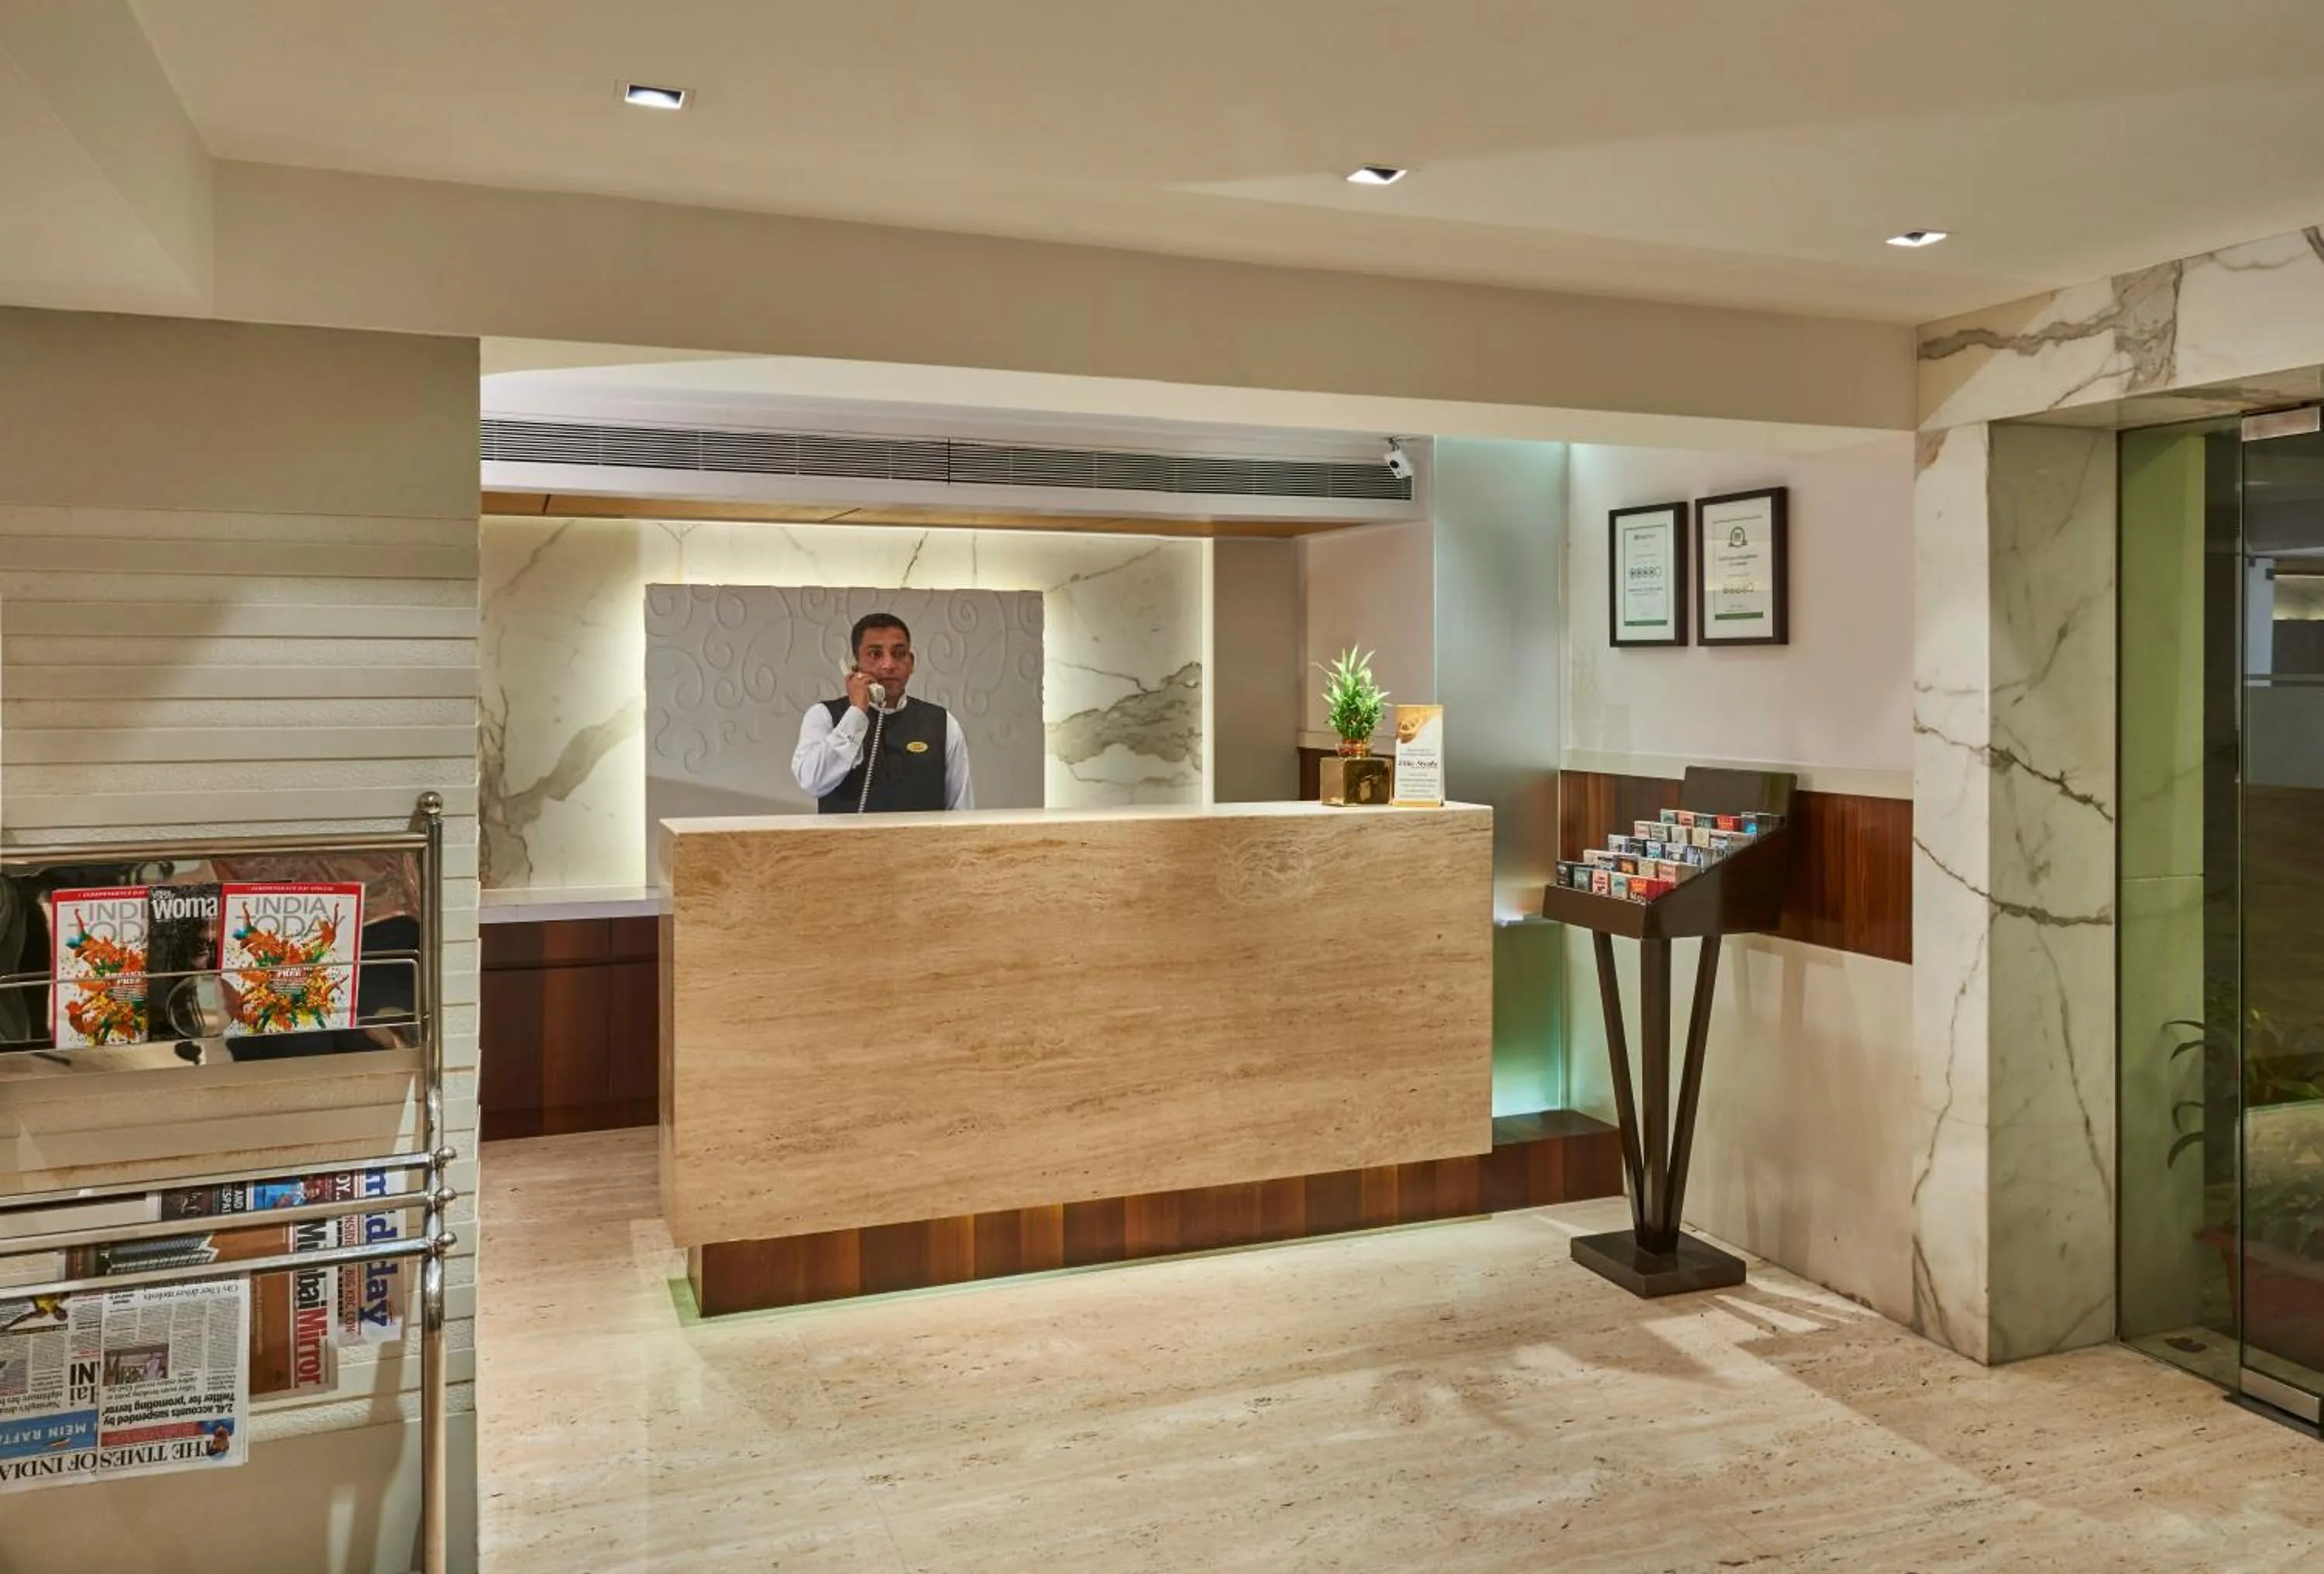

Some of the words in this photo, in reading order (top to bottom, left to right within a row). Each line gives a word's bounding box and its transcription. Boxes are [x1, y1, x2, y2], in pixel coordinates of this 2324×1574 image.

[88, 900, 147, 921] INDI
[151, 896, 218, 920] woma
[255, 896, 328, 915] INDIA
[345, 1215, 356, 1246] NSIDE
[359, 1169, 398, 1326] mdday
[69, 1361, 100, 1386] NI
[189, 1395, 201, 1405] for
[203, 1391, 235, 1404] Twitter
[103, 1414, 116, 1427] by
[117, 1410, 169, 1425] suspended
[171, 1405, 213, 1418] accounts
[48, 1422, 87, 1438] MEIN
[100, 1446, 168, 1468] TIMES
[172, 1440, 215, 1459] THE
[0, 1457, 64, 1482] INDIA
[68, 1452, 98, 1472] OF
